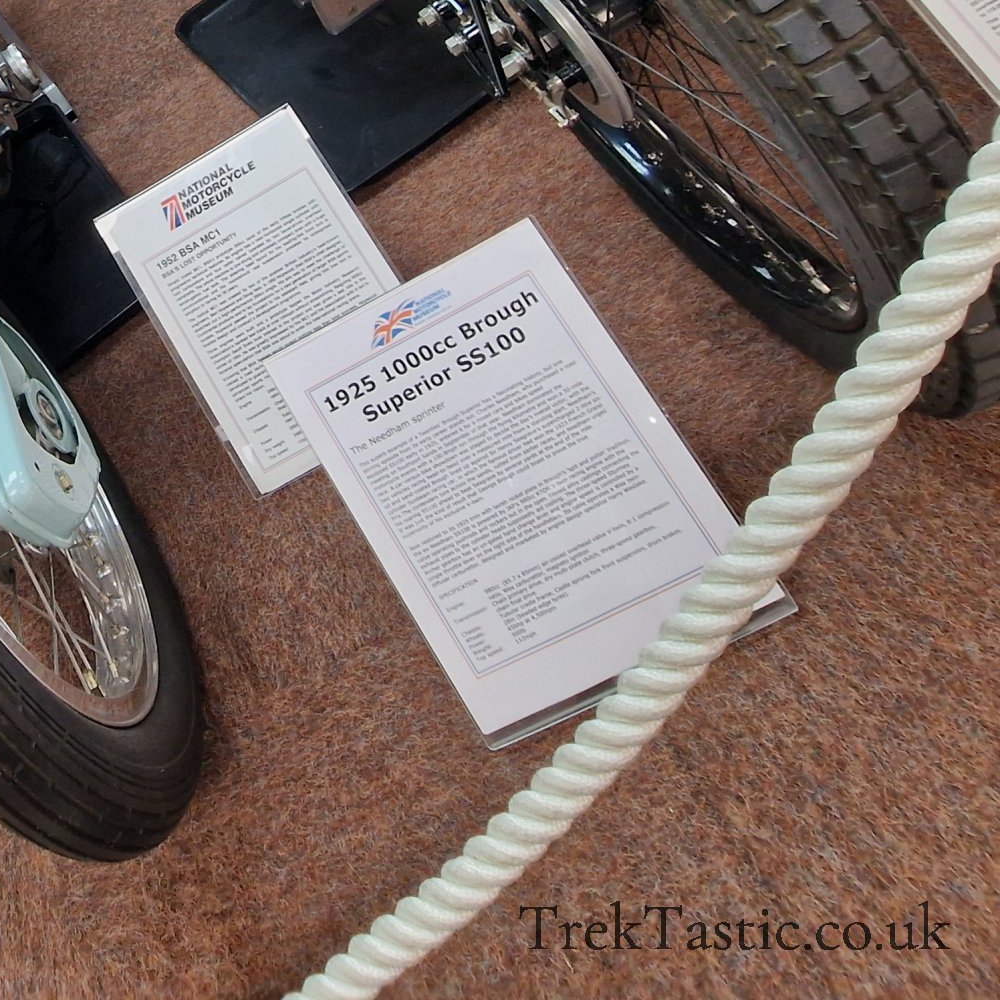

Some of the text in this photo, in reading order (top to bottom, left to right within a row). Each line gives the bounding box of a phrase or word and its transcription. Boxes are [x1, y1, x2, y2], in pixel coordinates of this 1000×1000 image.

[178, 162, 233, 200] NATIONAL
[181, 160, 257, 211] MOTORCYCLE
[185, 187, 235, 222] MUSEUM
[156, 228, 220, 270] 1952 BSA MC1
[162, 232, 236, 279] BSA'S LOST OPPORTUNITY
[324, 292, 538, 412] 1925 1000cc Brough
[362, 327, 525, 422] Superior SS100
[349, 401, 444, 454] The Needham sprinter
